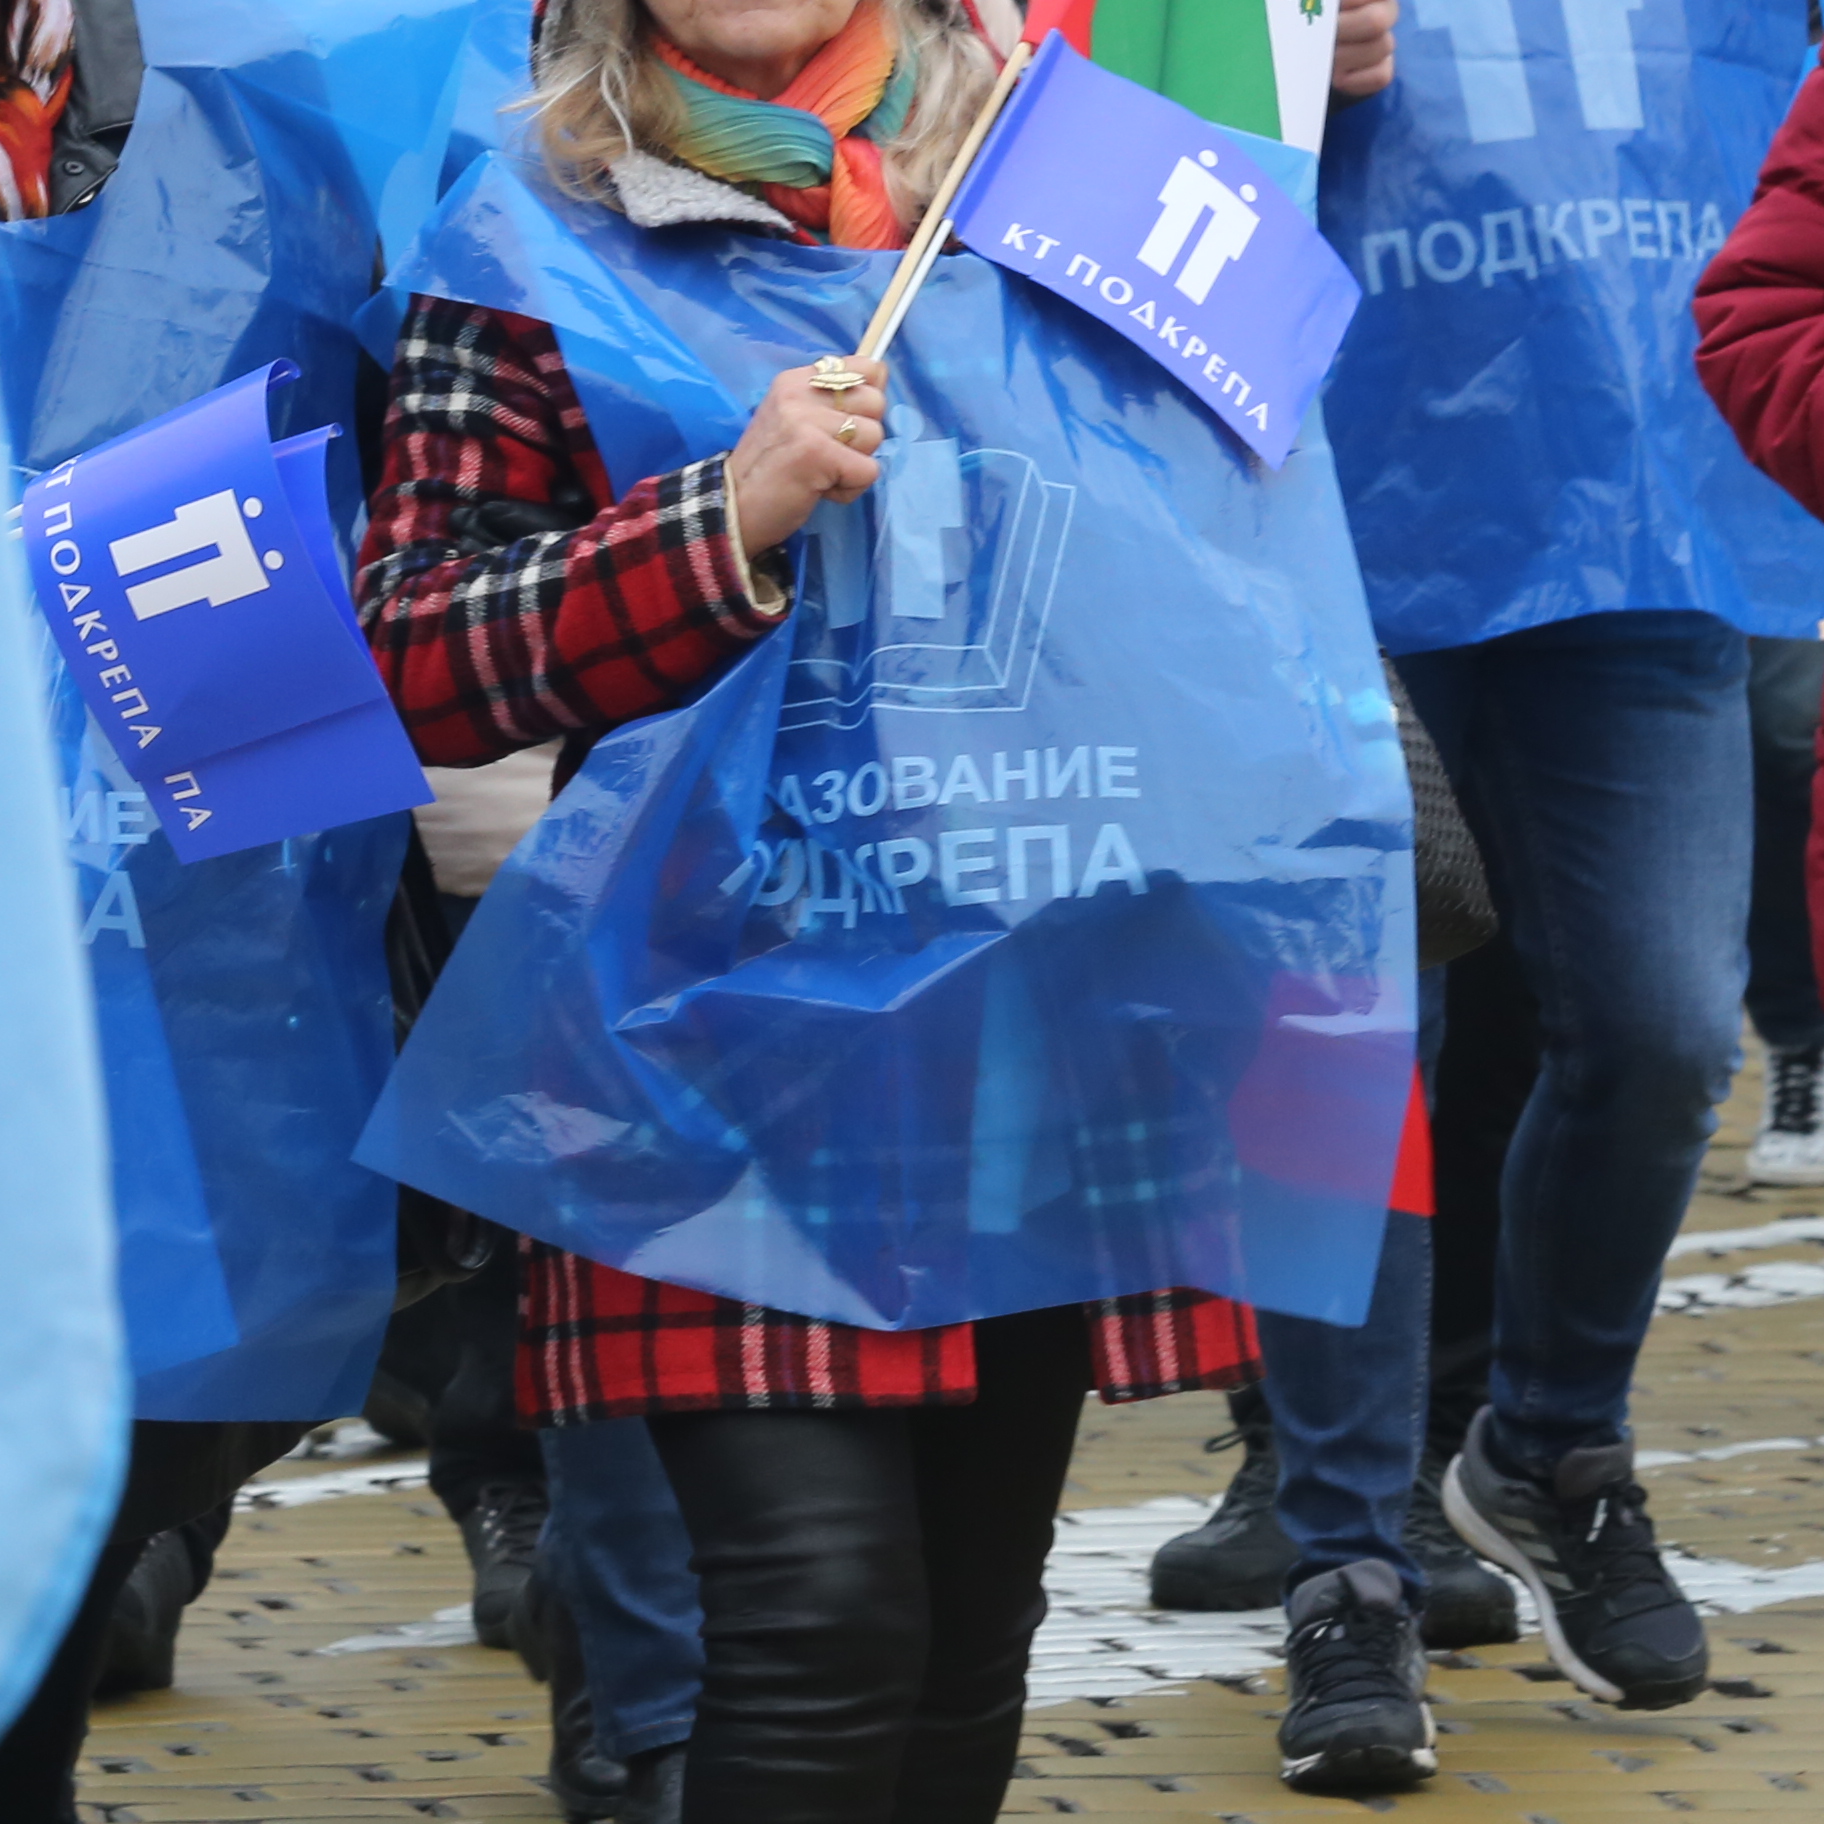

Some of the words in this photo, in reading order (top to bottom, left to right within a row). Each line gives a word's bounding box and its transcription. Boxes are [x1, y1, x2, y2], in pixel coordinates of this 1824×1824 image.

[1000, 220, 1062, 261] КТ
[1065, 252, 1270, 434] ПОДКРЕПА
[1359, 198, 1727, 296] ПОДКРЕПА
[42, 501, 163, 751] ПОДКРЕПА
[163, 770, 213, 832] ПА
